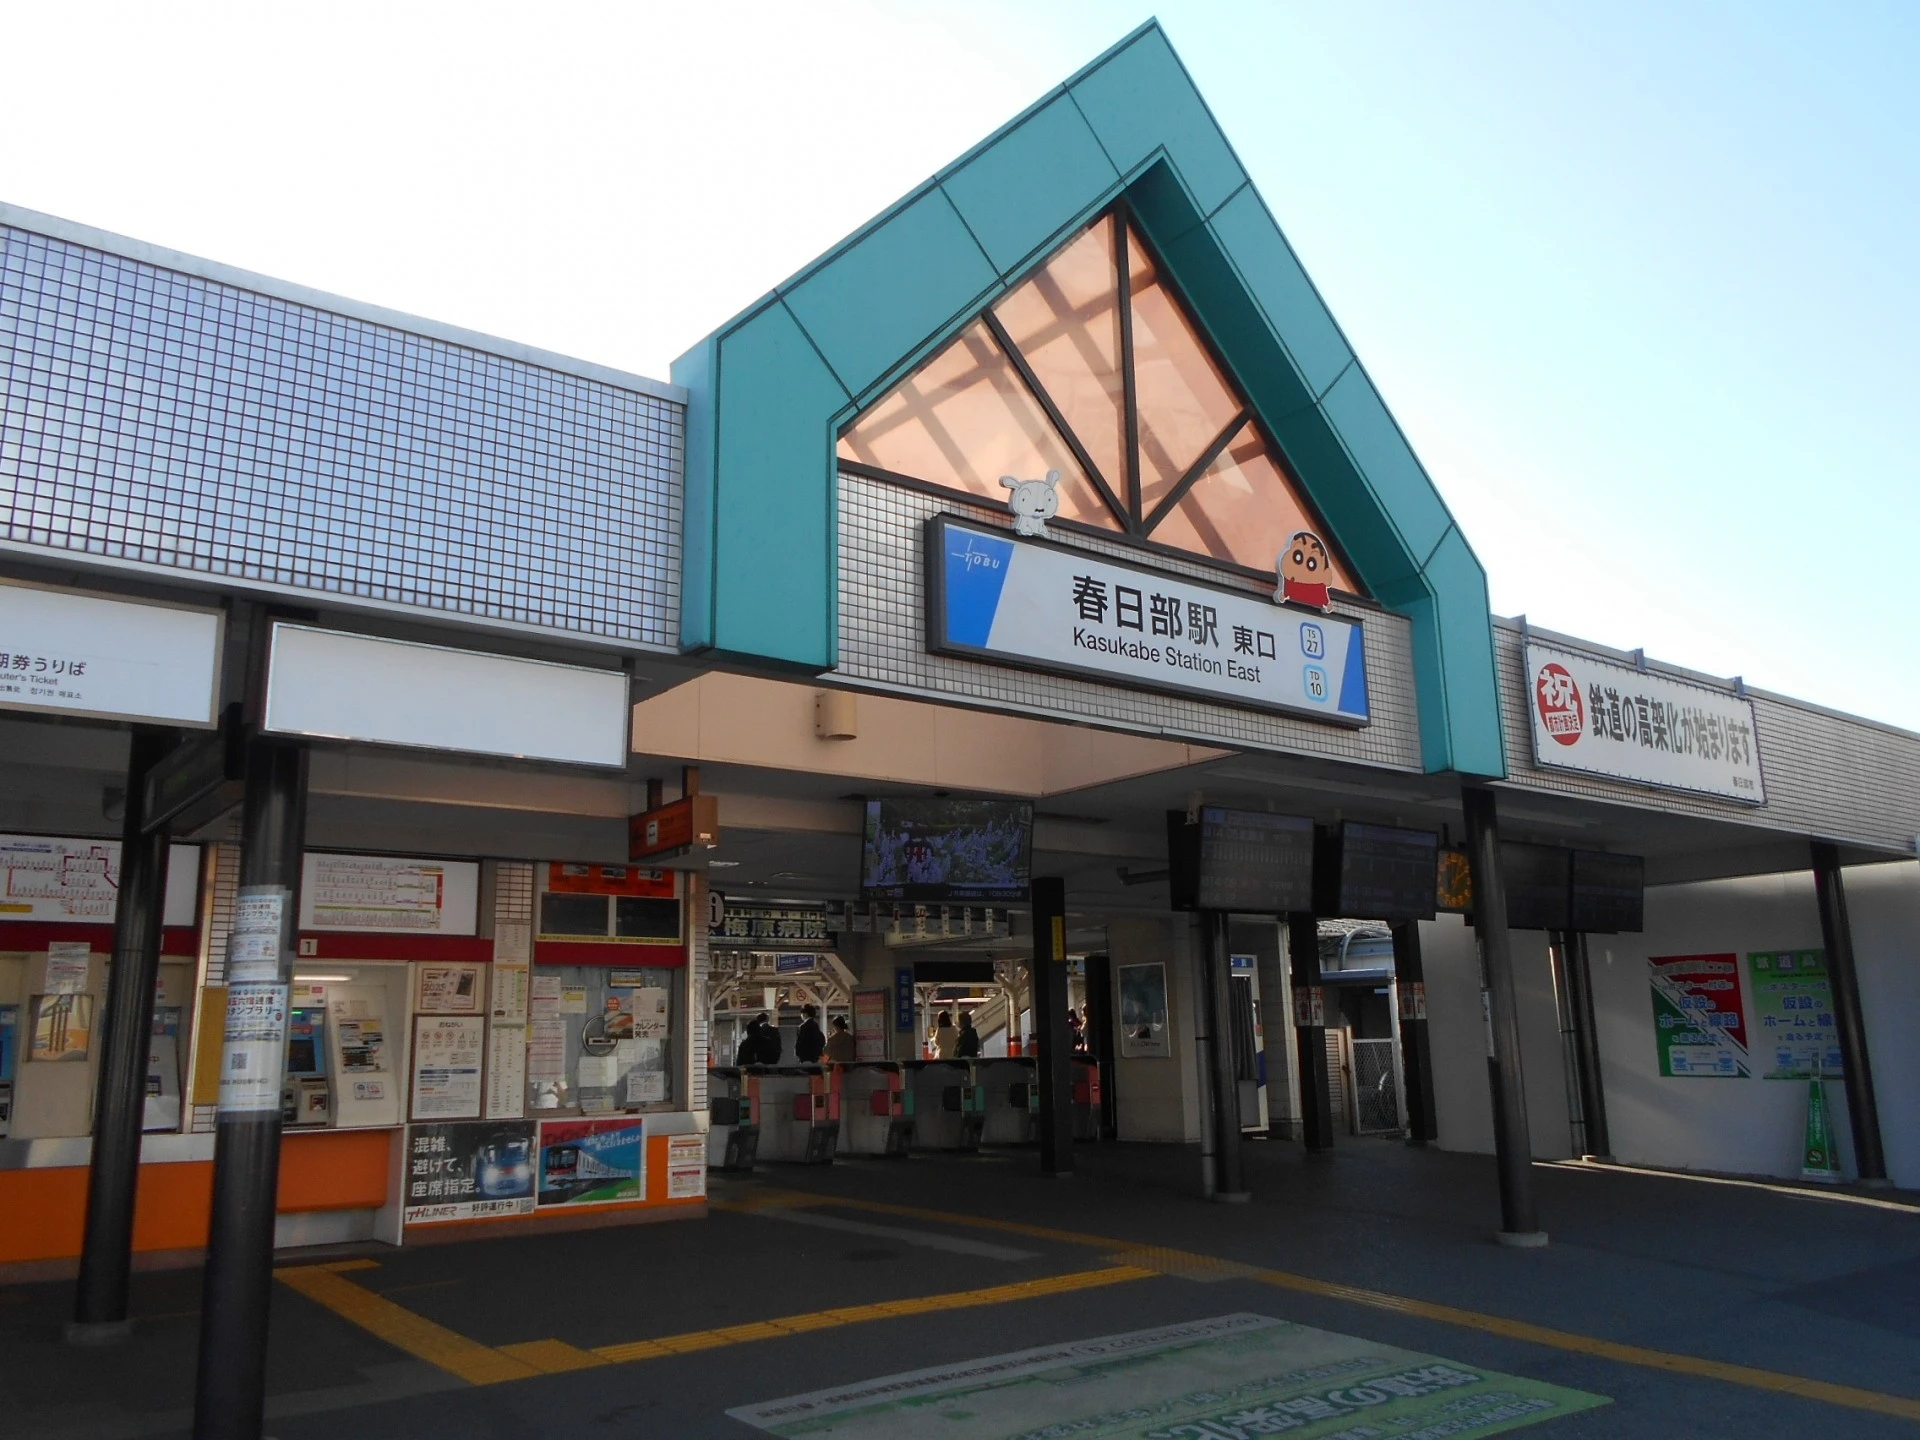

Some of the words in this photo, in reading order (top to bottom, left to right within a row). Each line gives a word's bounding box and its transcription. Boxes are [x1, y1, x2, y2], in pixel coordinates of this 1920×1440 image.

[1072, 576, 1219, 647] 春日部駅
[1233, 625, 1276, 661] 東口
[1307, 628, 1316, 638] TS
[1073, 628, 1160, 663] Kasukabe
[1166, 647, 1223, 676] Station
[1227, 659, 1260, 683] East
[1306, 639, 1318, 655] 27
[30, 674, 58, 685] Ticket
[1309, 670, 1320, 681] TD
[1310, 682, 1322, 697] 10
[1539, 669, 1578, 711] 祝
[1589, 683, 1750, 766] 鉄道の高架化が始まります
[725, 917, 826, 938] 梅原病院
[1783, 997, 1823, 1009] 仮設の
[634, 1022, 666, 1030] カレンダー
[1659, 1013, 1739, 1028] ホームと線路
[414, 1136, 451, 1154] 混雑、
[413, 1157, 462, 1175] 避けて、
[411, 1178, 481, 1197] 座席指定。
